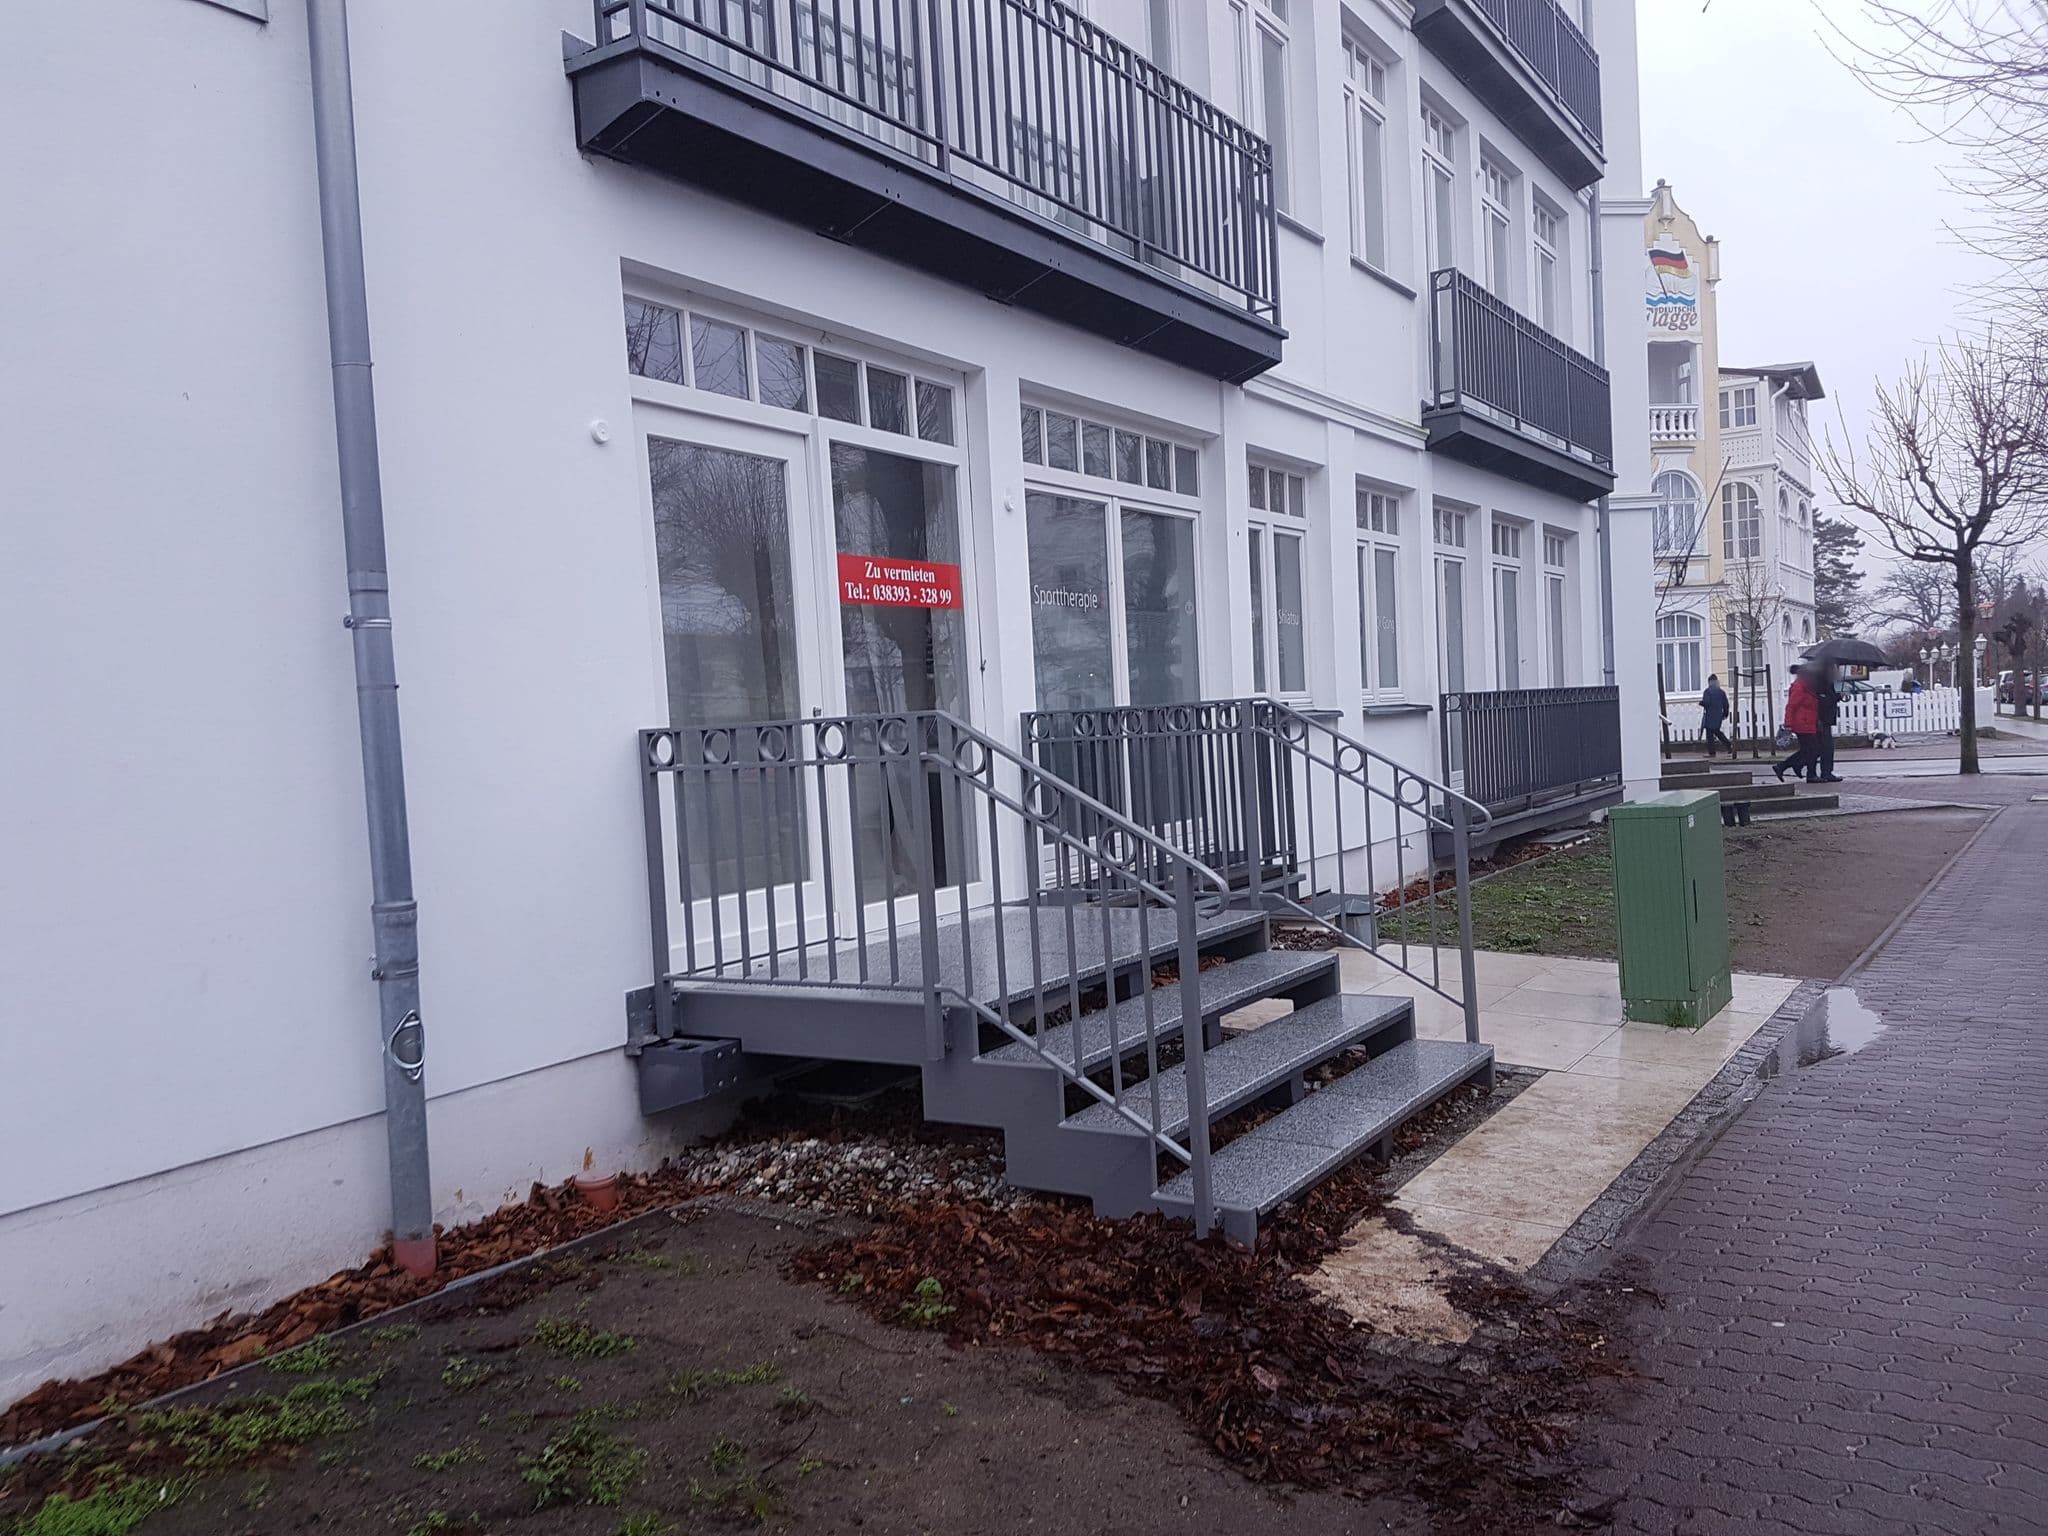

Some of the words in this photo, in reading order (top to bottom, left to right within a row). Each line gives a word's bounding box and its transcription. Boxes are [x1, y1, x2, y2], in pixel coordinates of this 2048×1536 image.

[865, 561, 881, 579] Zu
[884, 565, 935, 583] vermieten
[845, 582, 870, 600] Tel.:
[873, 584, 911, 602] 038393
[920, 588, 938, 604] 328
[940, 589, 952, 605] 99
[1033, 584, 1098, 613] Sporttherapie
[1278, 608, 1299, 625] Shiatsu
